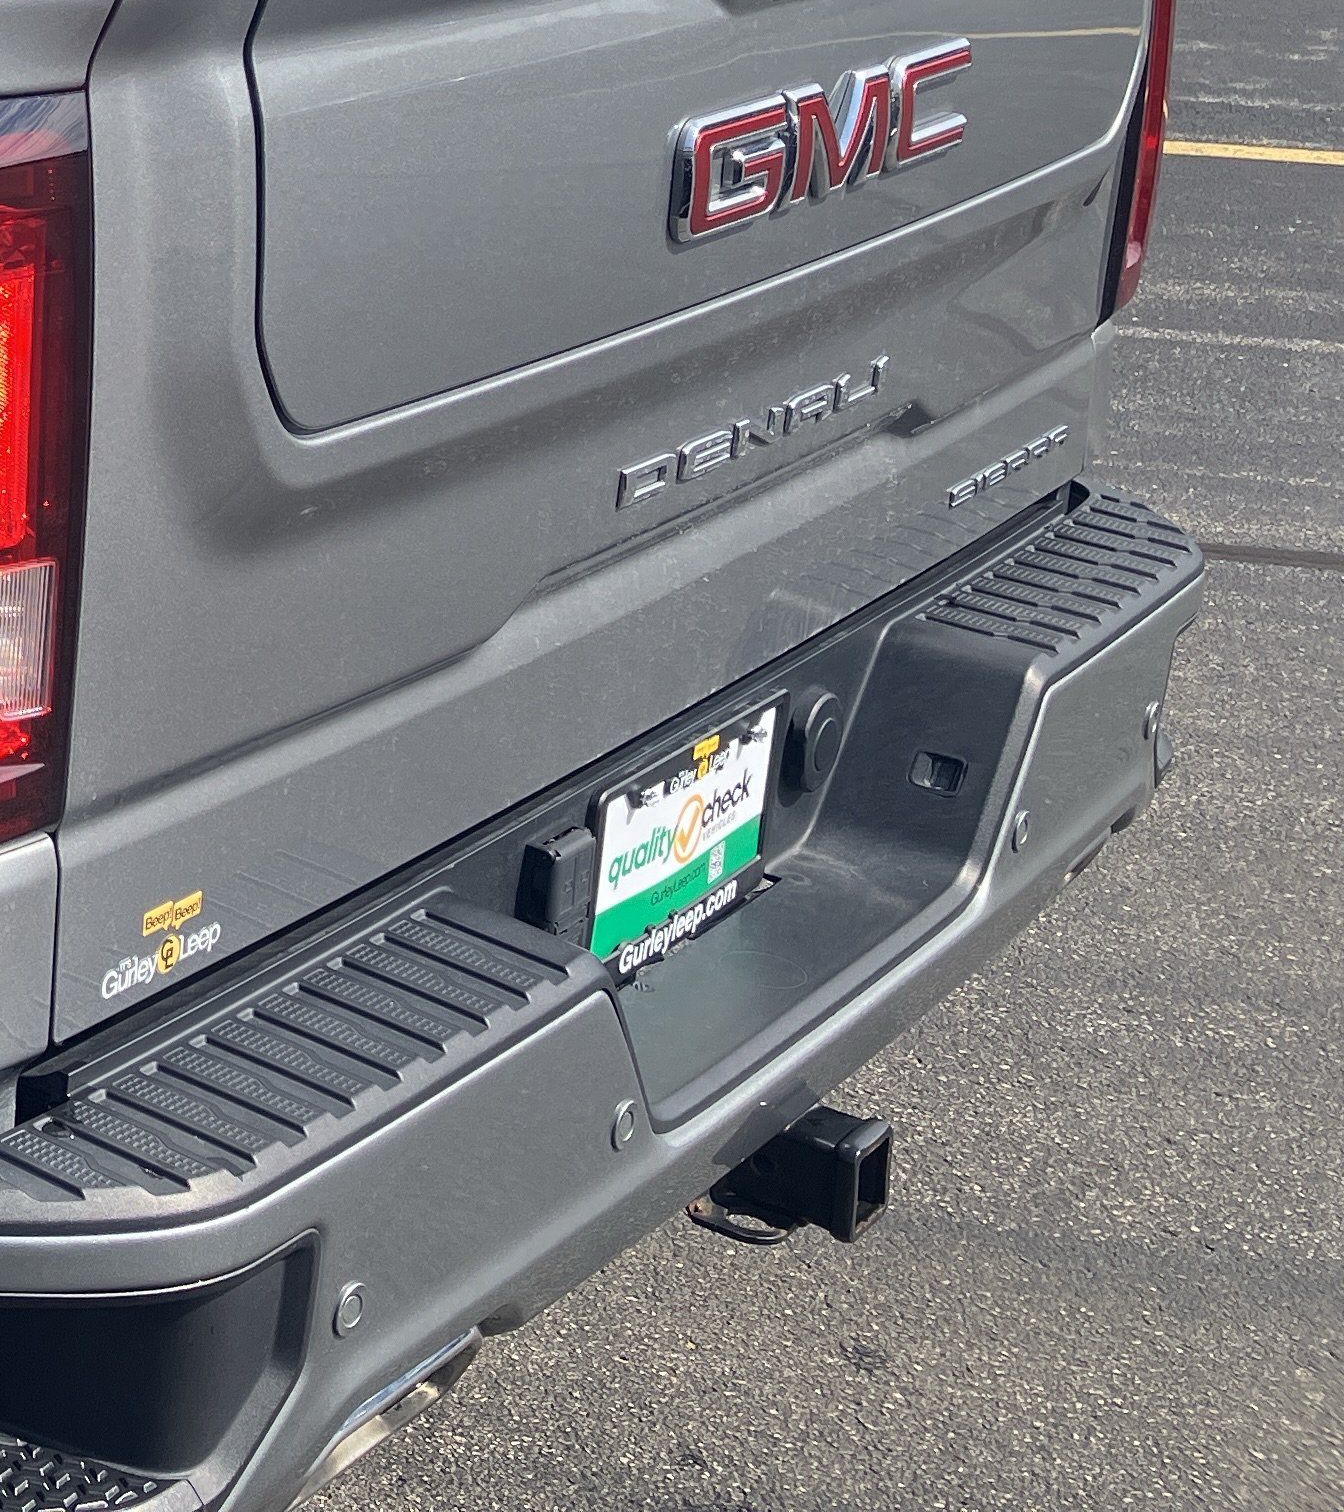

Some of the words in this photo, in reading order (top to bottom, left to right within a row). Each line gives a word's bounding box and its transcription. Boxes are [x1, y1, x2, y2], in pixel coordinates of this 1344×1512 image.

[669, 38, 972, 244] GMC
[616, 354, 890, 510] DENALI
[948, 424, 1069, 508] SIERRA
[607, 825, 673, 890] quality
[701, 767, 753, 828] check
[101, 951, 160, 1000] Gurley
[178, 922, 221, 961] Leep
[145, 907, 173, 931] Beep!
[174, 897, 202, 921] Beep!
